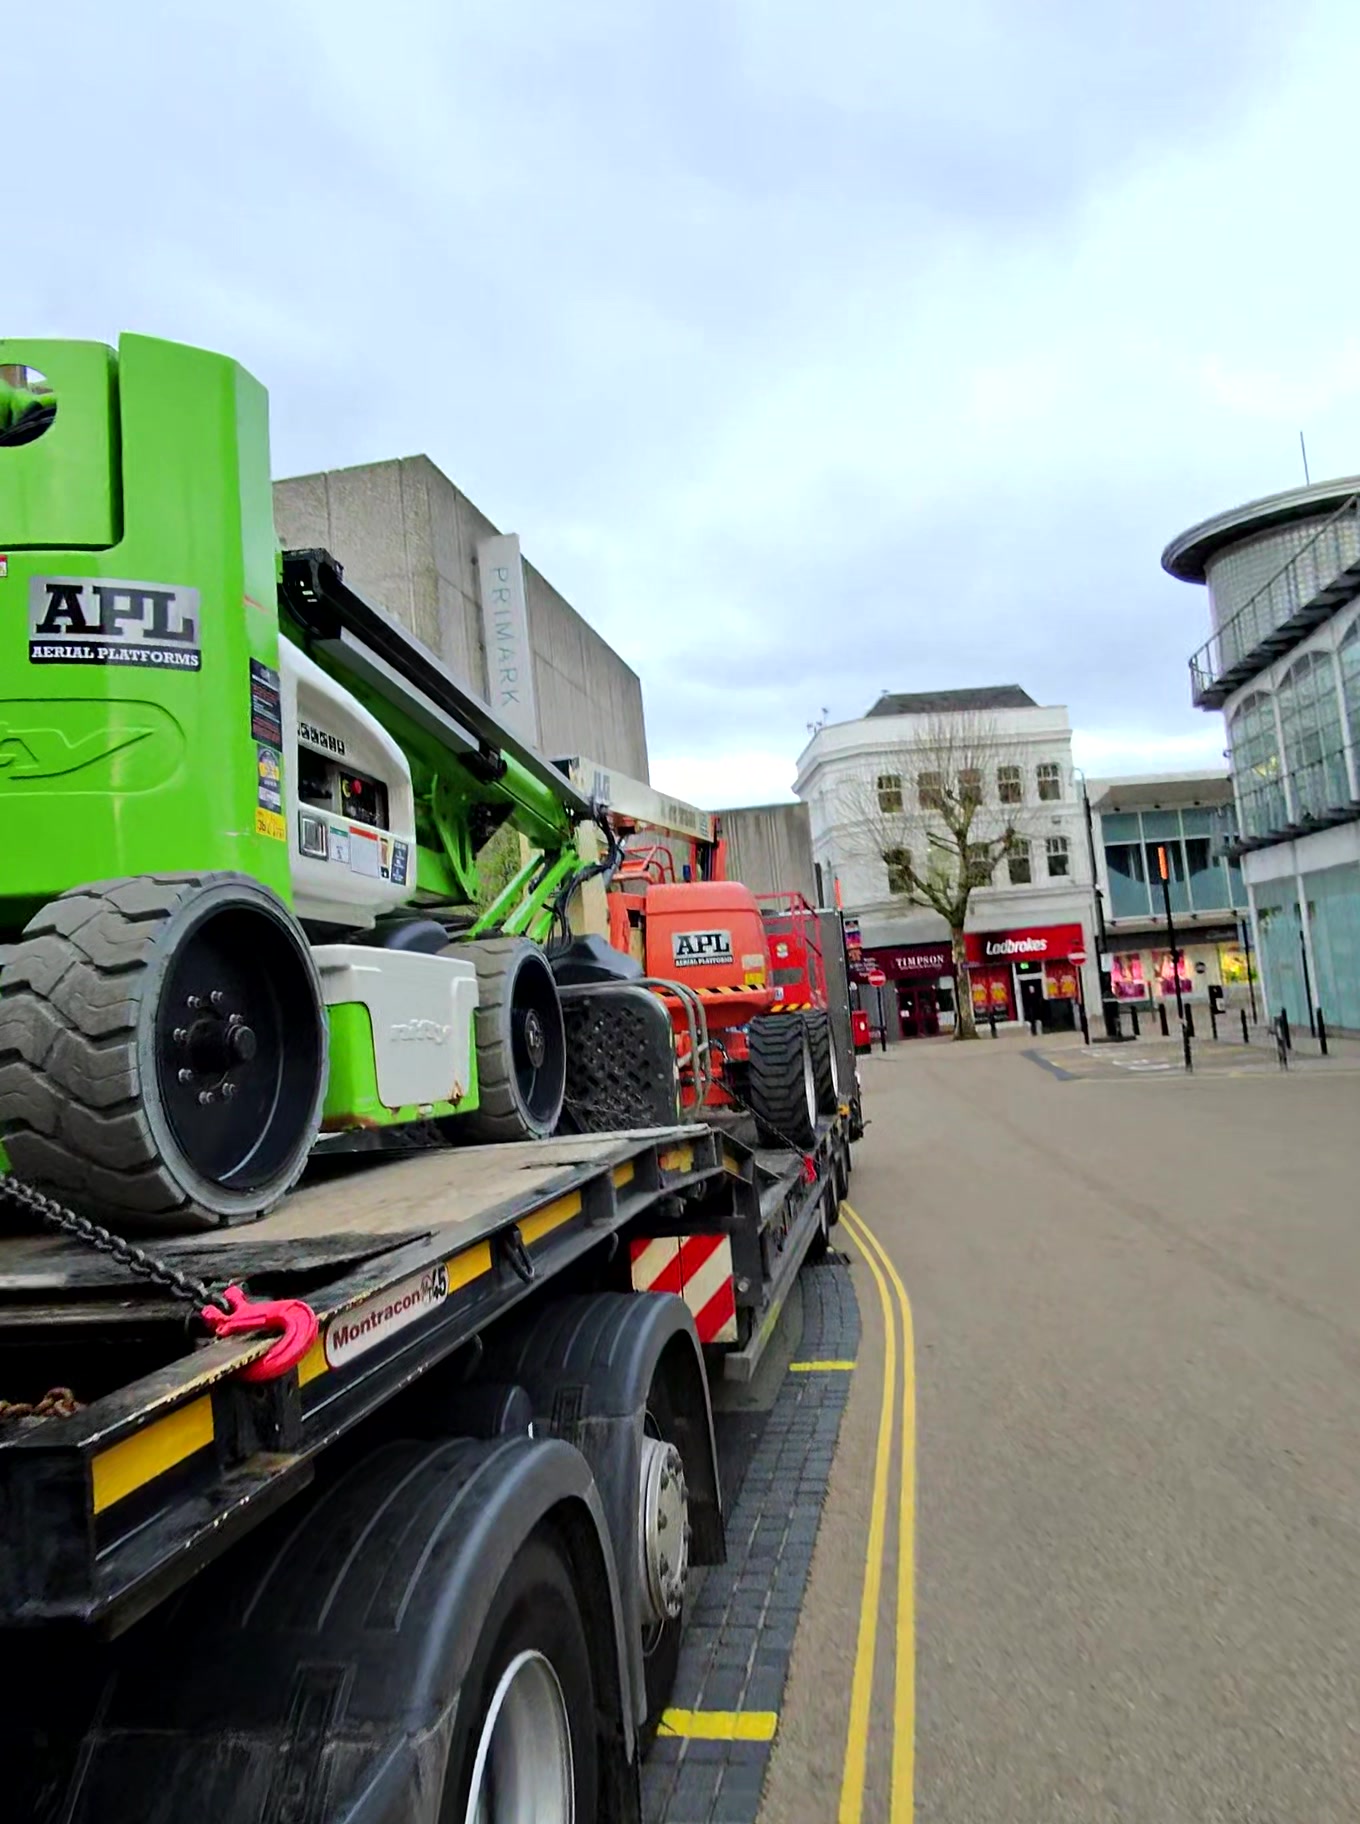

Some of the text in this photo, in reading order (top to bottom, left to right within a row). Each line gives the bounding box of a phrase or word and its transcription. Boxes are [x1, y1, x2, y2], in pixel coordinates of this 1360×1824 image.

[36, 584, 195, 642] APL
[491, 567, 520, 706] PRIMARK
[32, 646, 199, 667] AERIAL PLATFORMS
[676, 933, 730, 956] APL
[986, 937, 1048, 956] Ladbrokes
[895, 954, 944, 967] TIMPSON
[332, 1289, 420, 1350] Montracon
